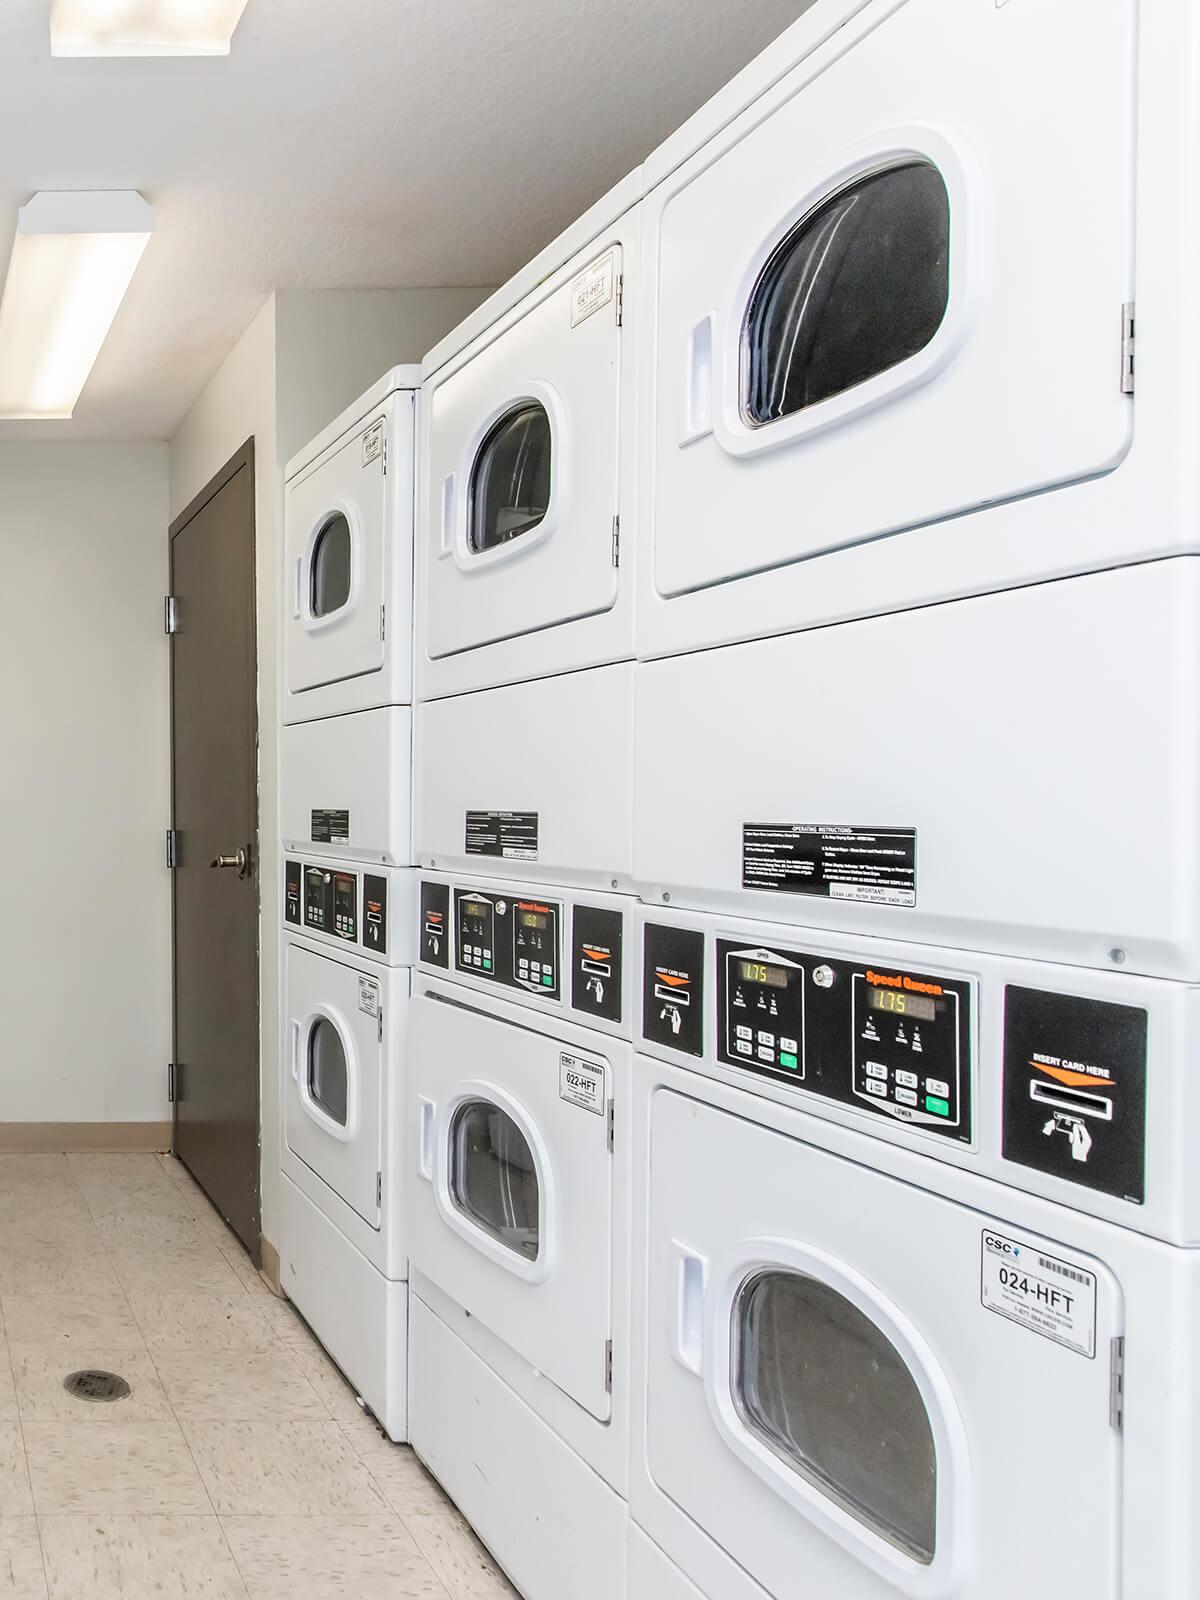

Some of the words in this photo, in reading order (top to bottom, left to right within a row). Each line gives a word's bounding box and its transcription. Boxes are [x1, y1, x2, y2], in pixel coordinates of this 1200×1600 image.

[866, 970, 902, 987] Speed
[903, 976, 944, 995] Queen
[1033, 1053, 1061, 1066] INSERT
[1062, 1059, 1085, 1072] CARD
[1086, 1066, 1110, 1079] HERE
[566, 1073, 596, 1093] 022-HFT
[894, 1107, 912, 1118] LOWER
[985, 1236, 1011, 1253] CSC
[999, 1268, 1074, 1313] 024-HFT
